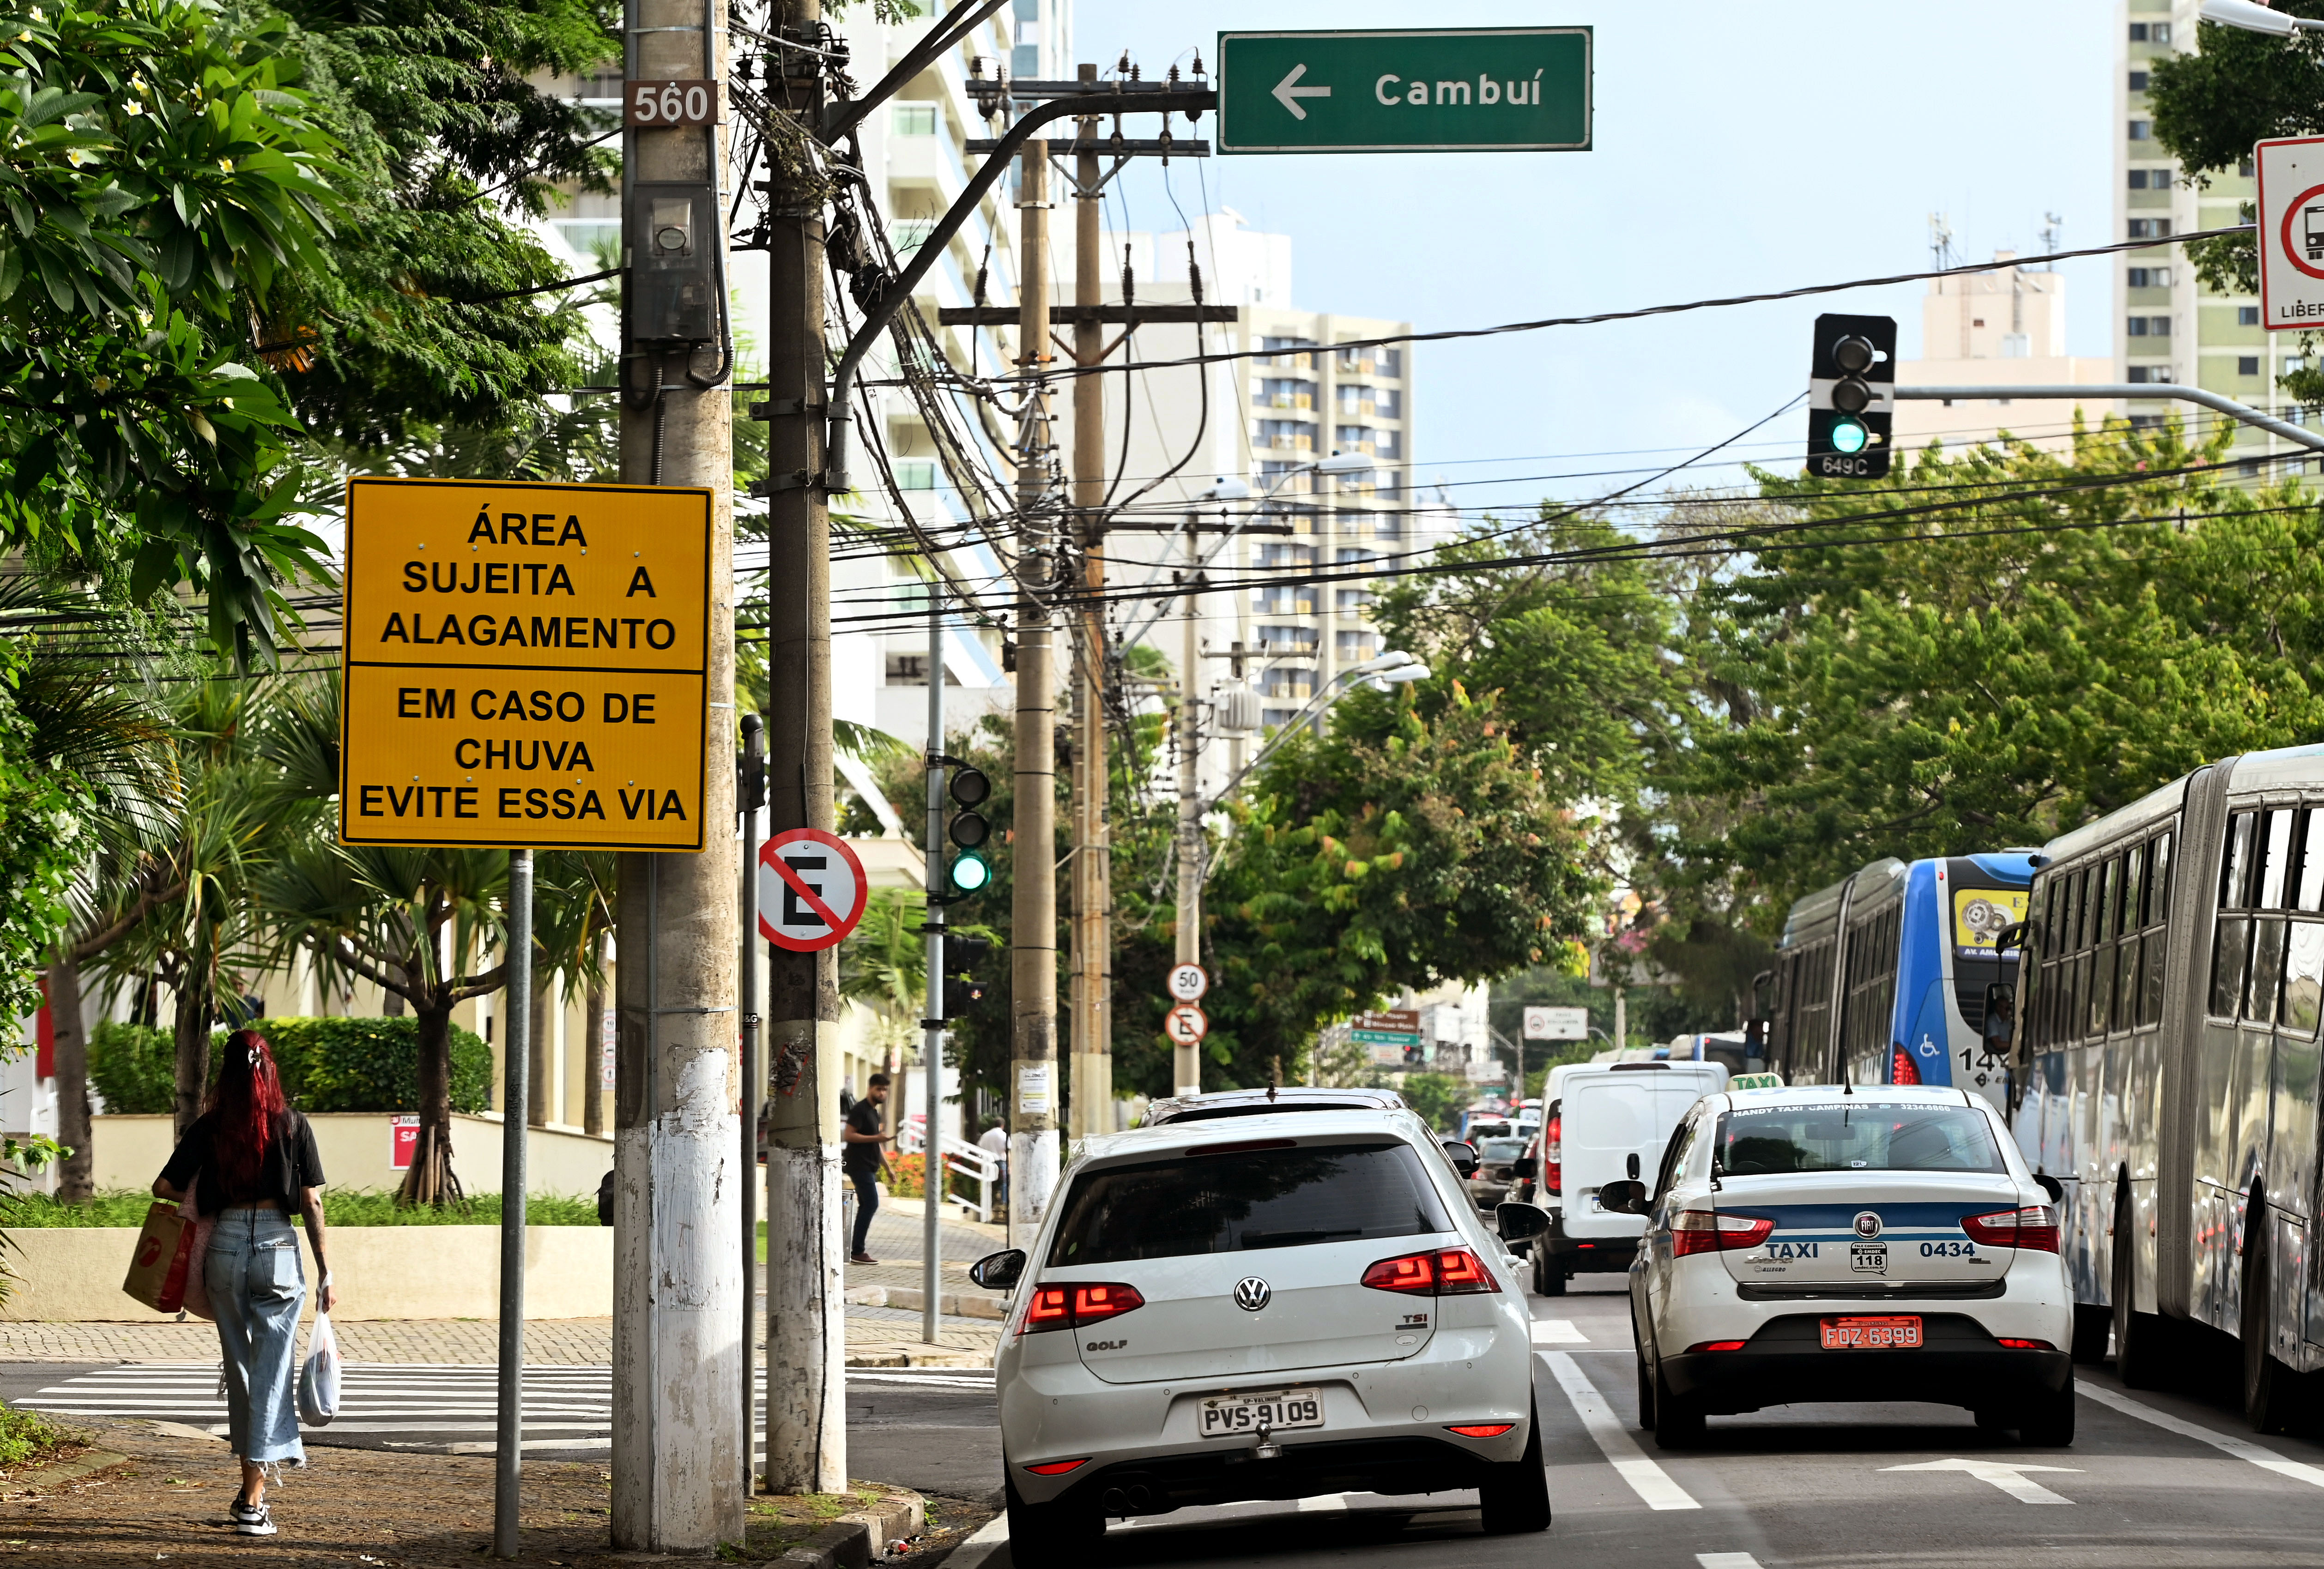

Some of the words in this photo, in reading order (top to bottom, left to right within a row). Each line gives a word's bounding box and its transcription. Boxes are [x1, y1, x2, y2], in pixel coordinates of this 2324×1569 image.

[1375, 68, 1544, 105] Cambuí
[635, 86, 708, 122] 560
[1822, 457, 1868, 474] 649C
[467, 503, 587, 547] ÁREA
[403, 561, 575, 596] SUJEITA
[626, 566, 657, 598] A
[380, 612, 676, 649] ALAGAMENTO
[398, 688, 455, 719] EM
[471, 690, 585, 722] CASO
[604, 694, 656, 724] DE
[455, 738, 594, 772] CHUVA
[360, 785, 478, 818] EVITE
[499, 788, 606, 821] ESSA
[617, 789, 686, 821] VIA
[783, 857, 827, 926] E
[1179, 972, 1198, 987] 50
[742, 1014, 757, 1023] &G
[1179, 1014, 1192, 1035] E
[1733, 1074, 1777, 1090] TAXI
[1733, 1108, 1773, 1117] HANDY
[1861, 1220, 1874, 1231] FIAT
[1766, 1243, 1818, 1258] TAXI
[1920, 1242, 1975, 1257] 0434
[1744, 1255, 1793, 1264] Siena
[1857, 1255, 1882, 1265] 118
[1403, 1314, 1428, 1323] TSI
[1087, 1340, 1127, 1351] GOLF
[1243, 1396, 1282, 1405] SP-VALINHOS
